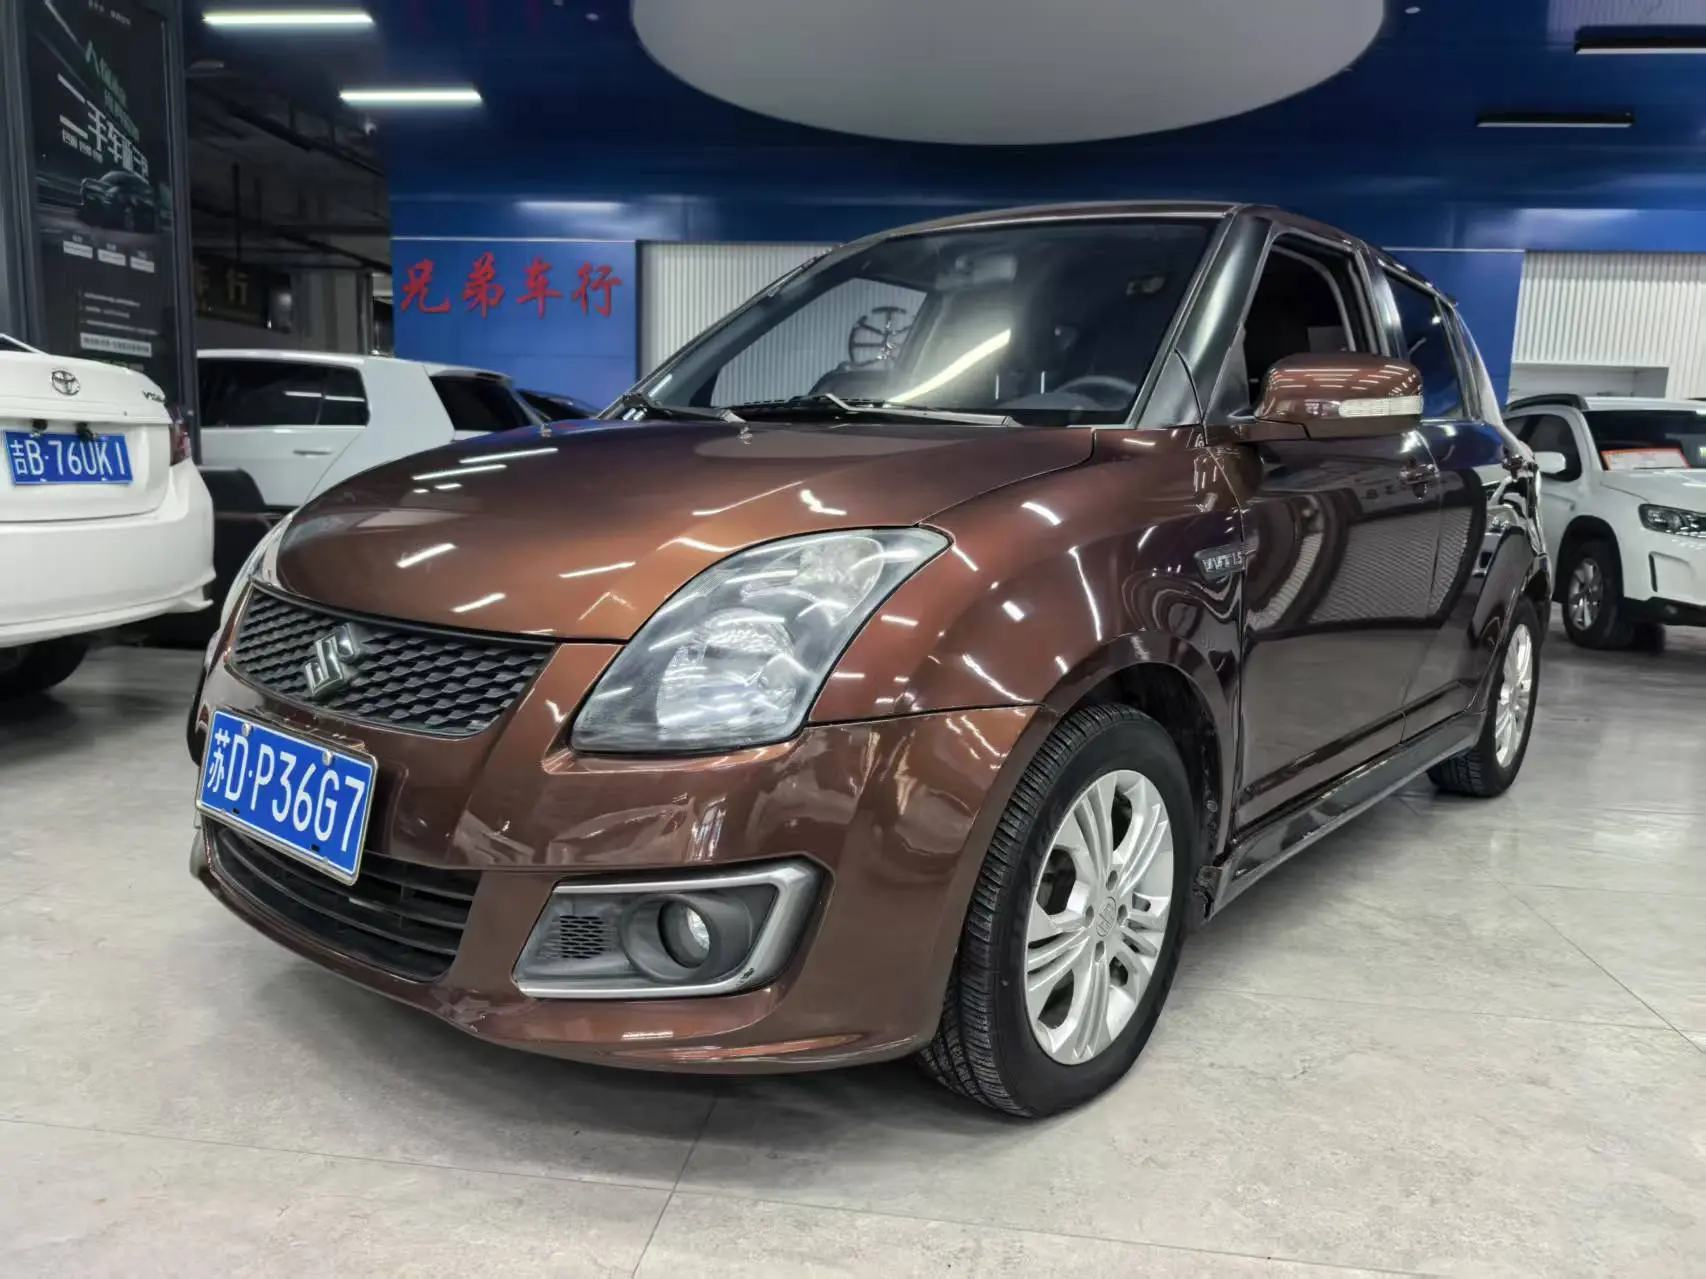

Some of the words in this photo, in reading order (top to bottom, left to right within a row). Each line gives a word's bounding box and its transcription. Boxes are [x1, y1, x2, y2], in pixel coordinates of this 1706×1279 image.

[400, 251, 623, 320] 兄弟车行
[10, 439, 126, 476] 吉B·76UK1
[207, 728, 366, 853] 苏D·P36G7
